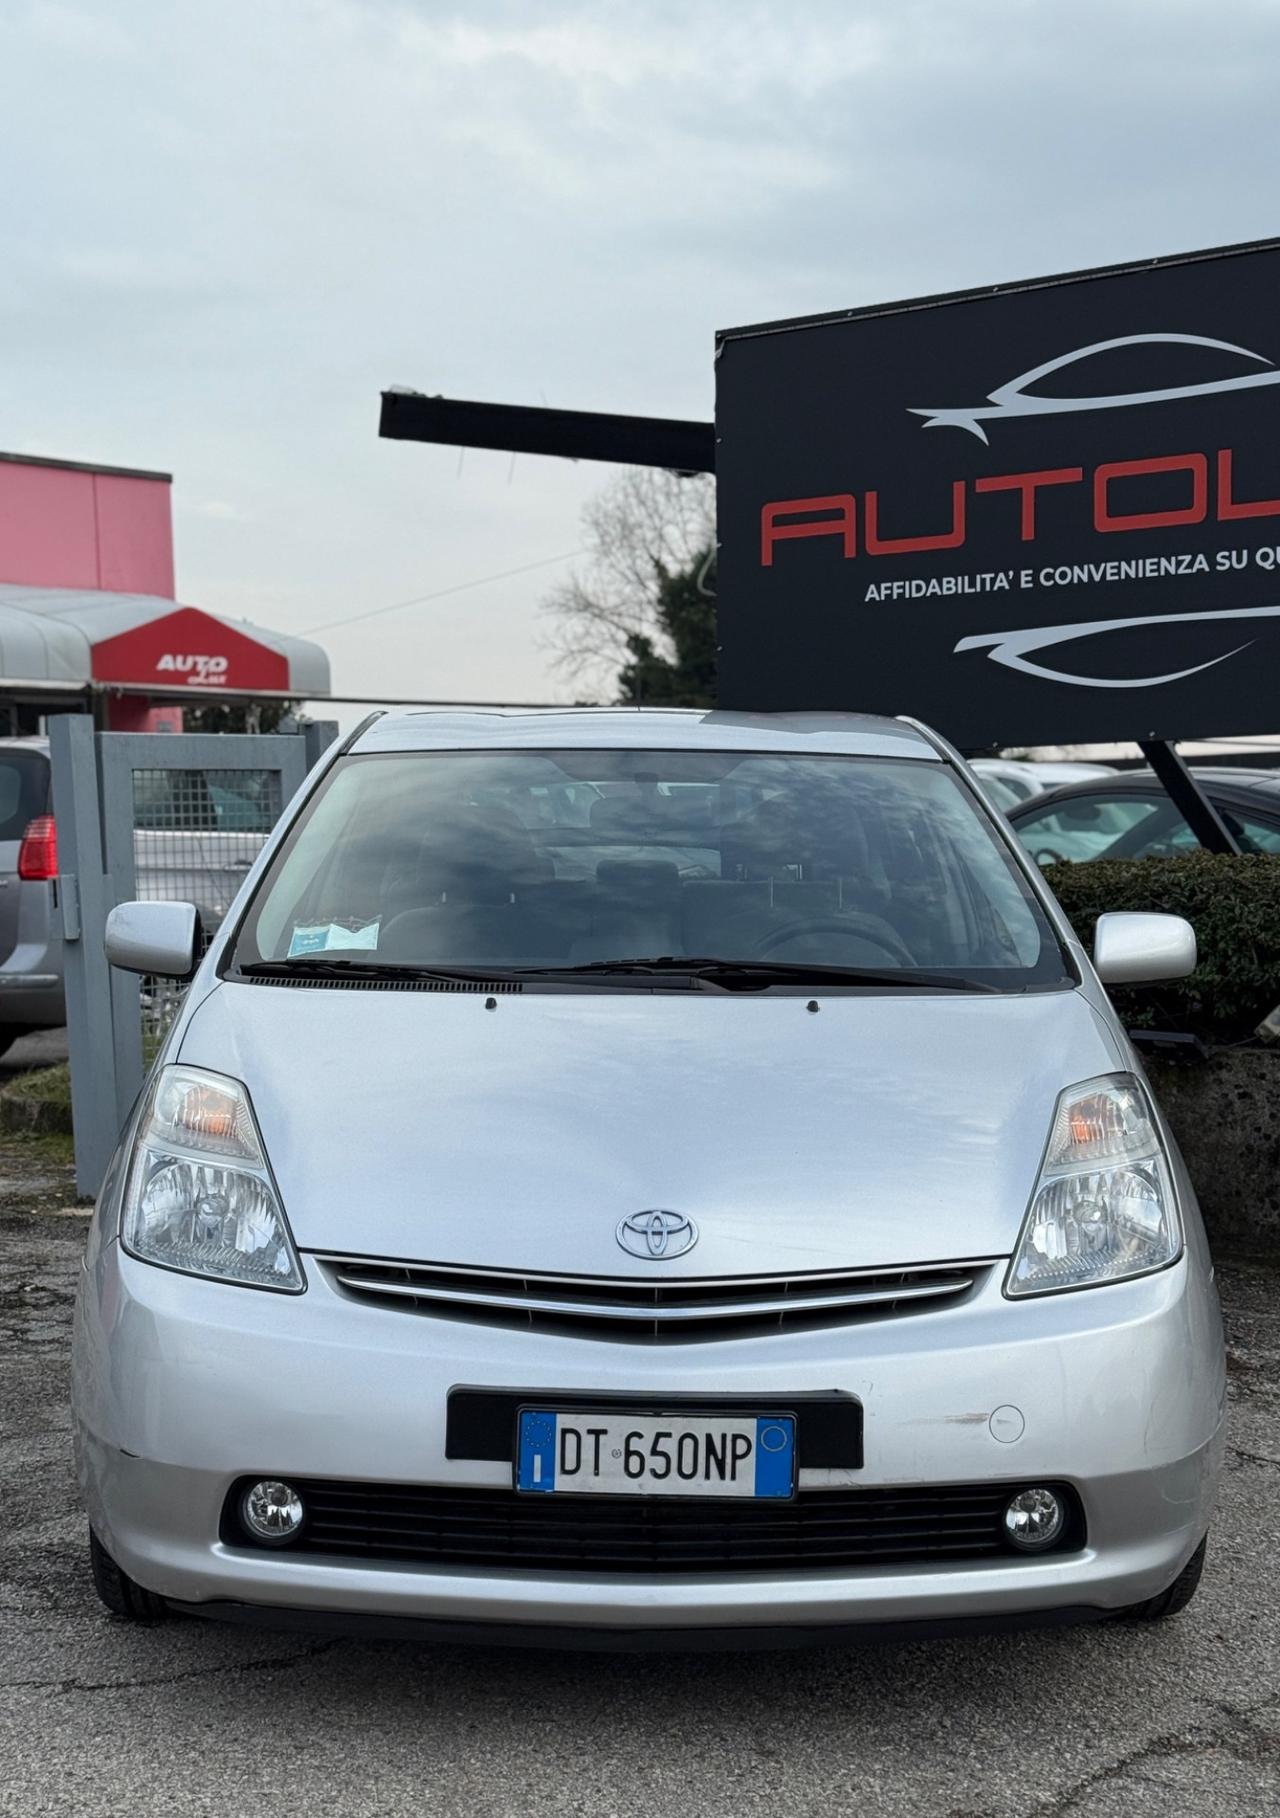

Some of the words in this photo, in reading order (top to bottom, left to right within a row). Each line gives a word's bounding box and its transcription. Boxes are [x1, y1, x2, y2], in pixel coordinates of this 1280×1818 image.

[761, 449, 1280, 566] AUTOL
[1020, 570, 1033, 588] E
[1039, 554, 1210, 587] CONVENIENZA
[1215, 549, 1248, 571] SU
[1255, 546, 1280, 571] Q
[156, 654, 228, 673] AUTO
[560, 1428, 608, 1476] DT
[623, 1431, 752, 1481] 650NP
